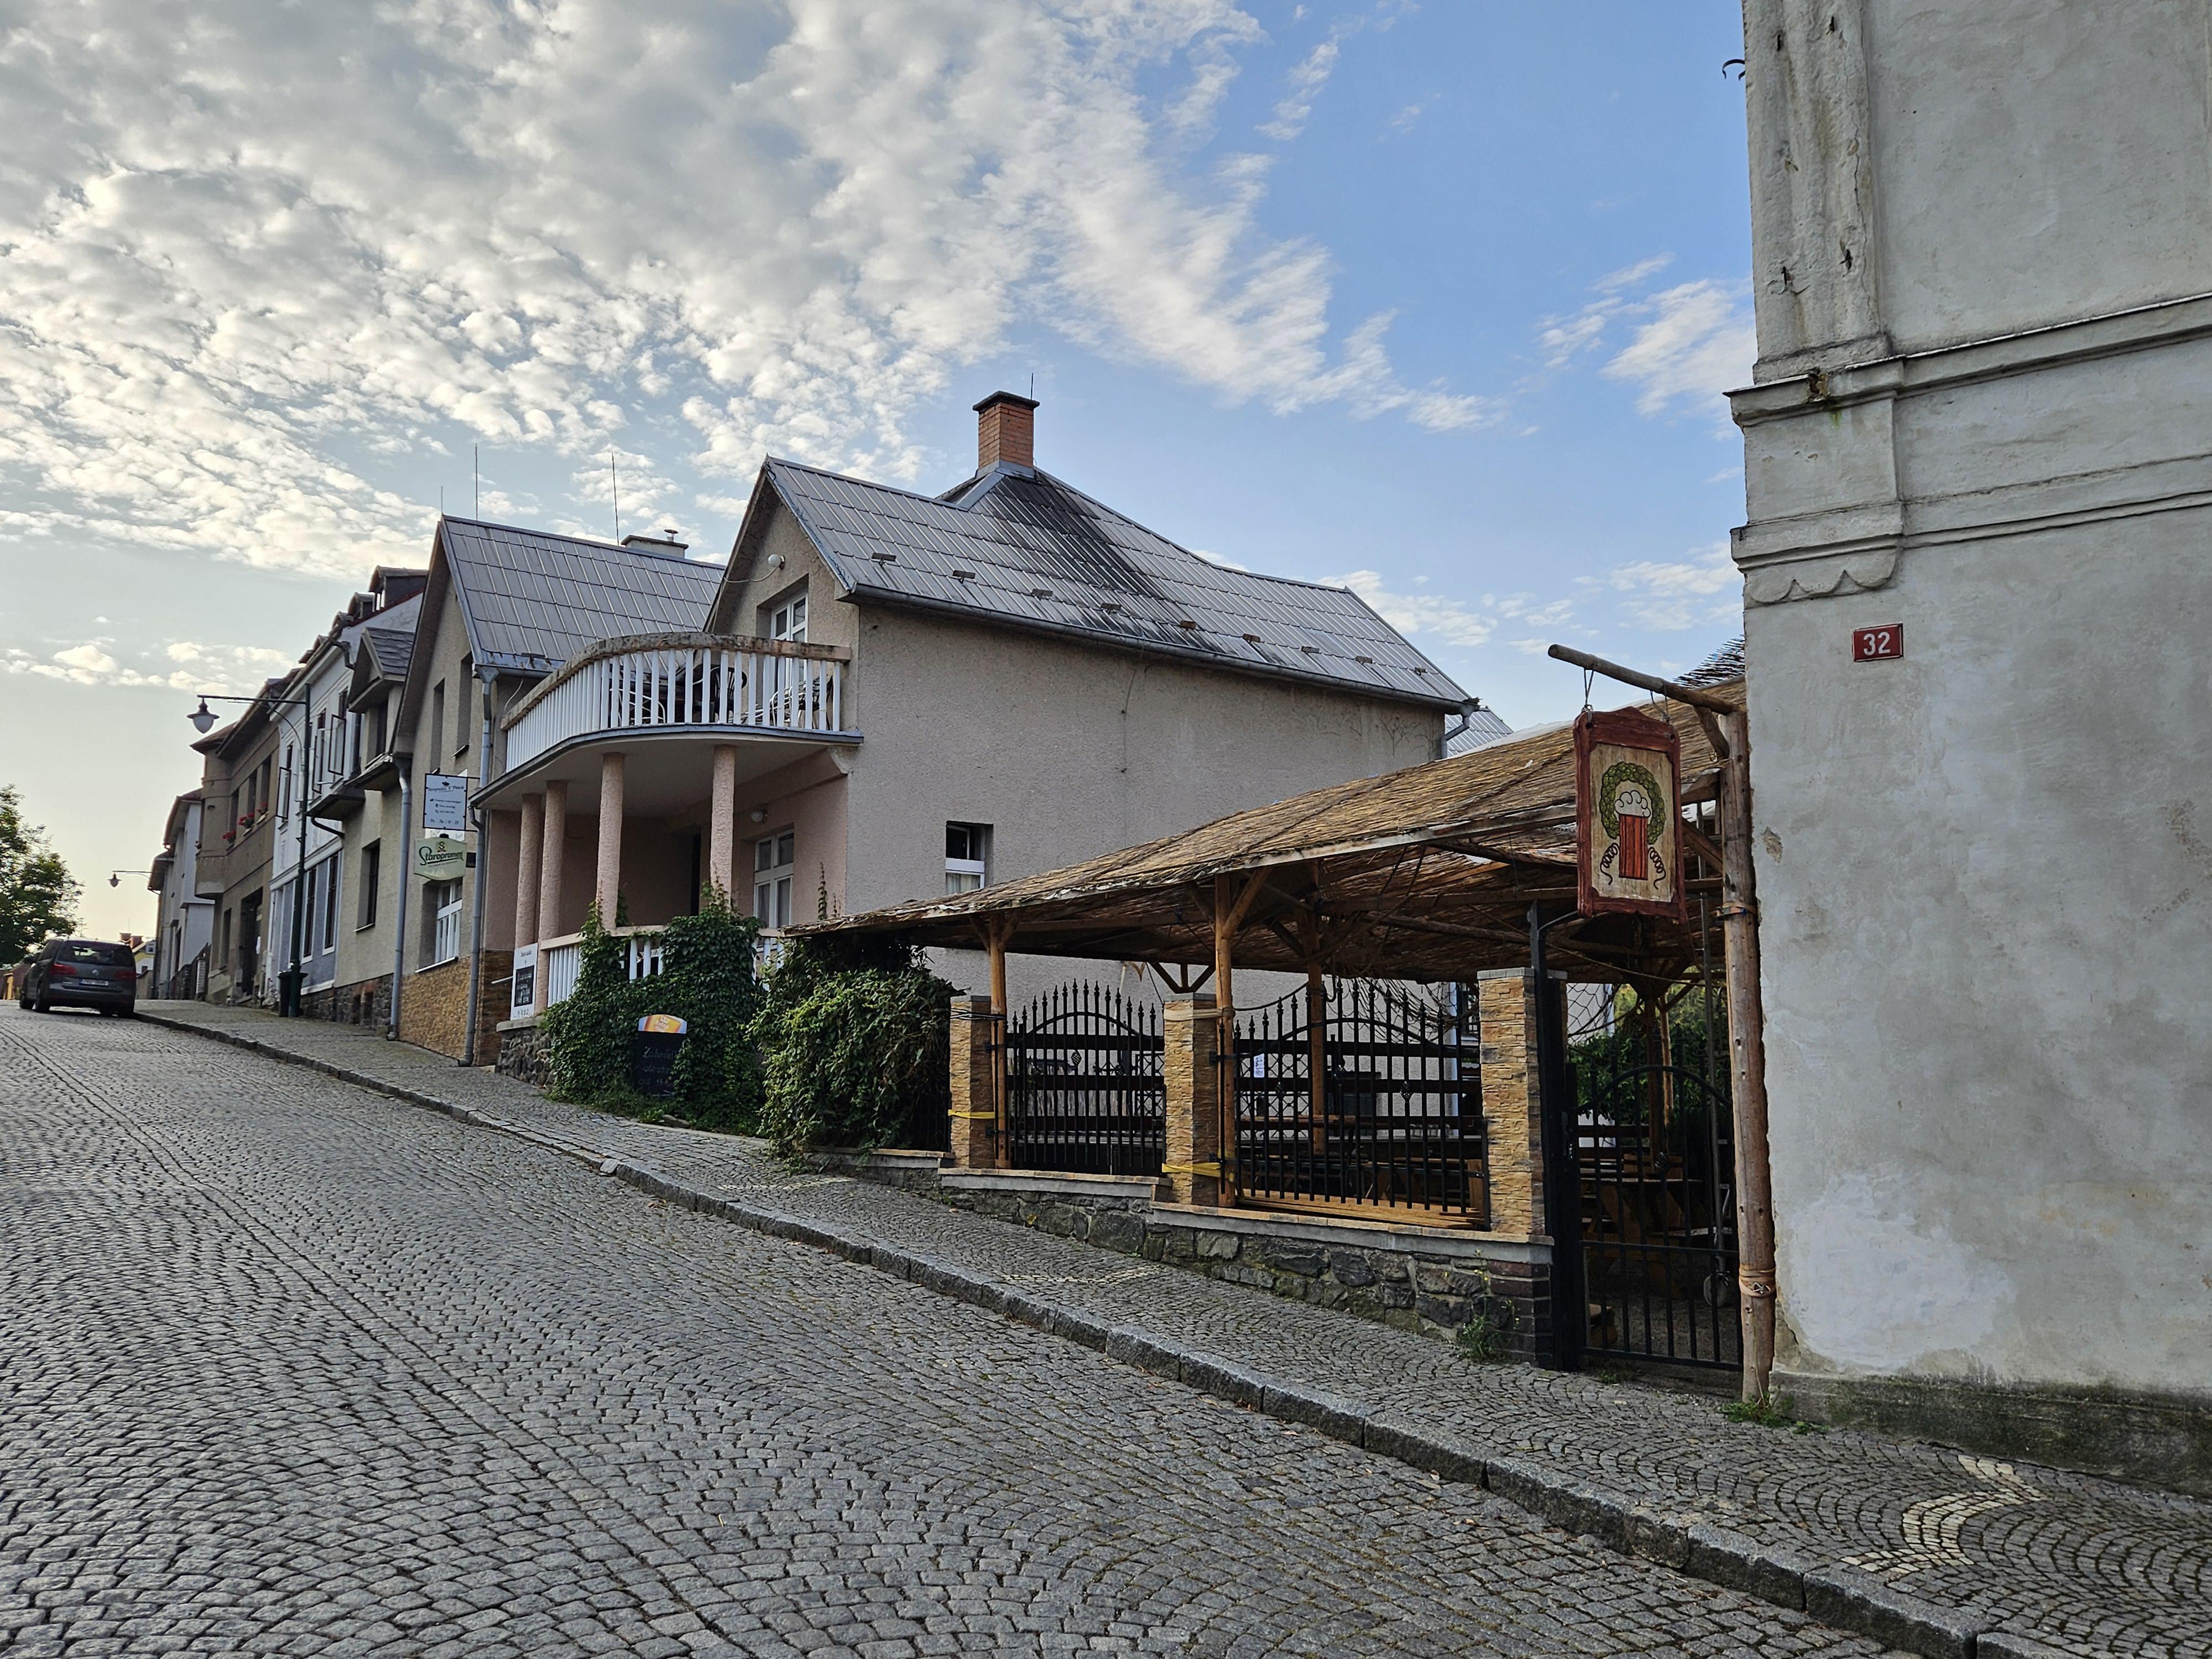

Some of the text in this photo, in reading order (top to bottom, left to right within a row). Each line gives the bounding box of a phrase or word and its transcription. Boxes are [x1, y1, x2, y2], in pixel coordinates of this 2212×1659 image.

[1863, 631, 1891, 656] 32
[438, 841, 445, 850] S
[419, 846, 464, 865] Staropramen
